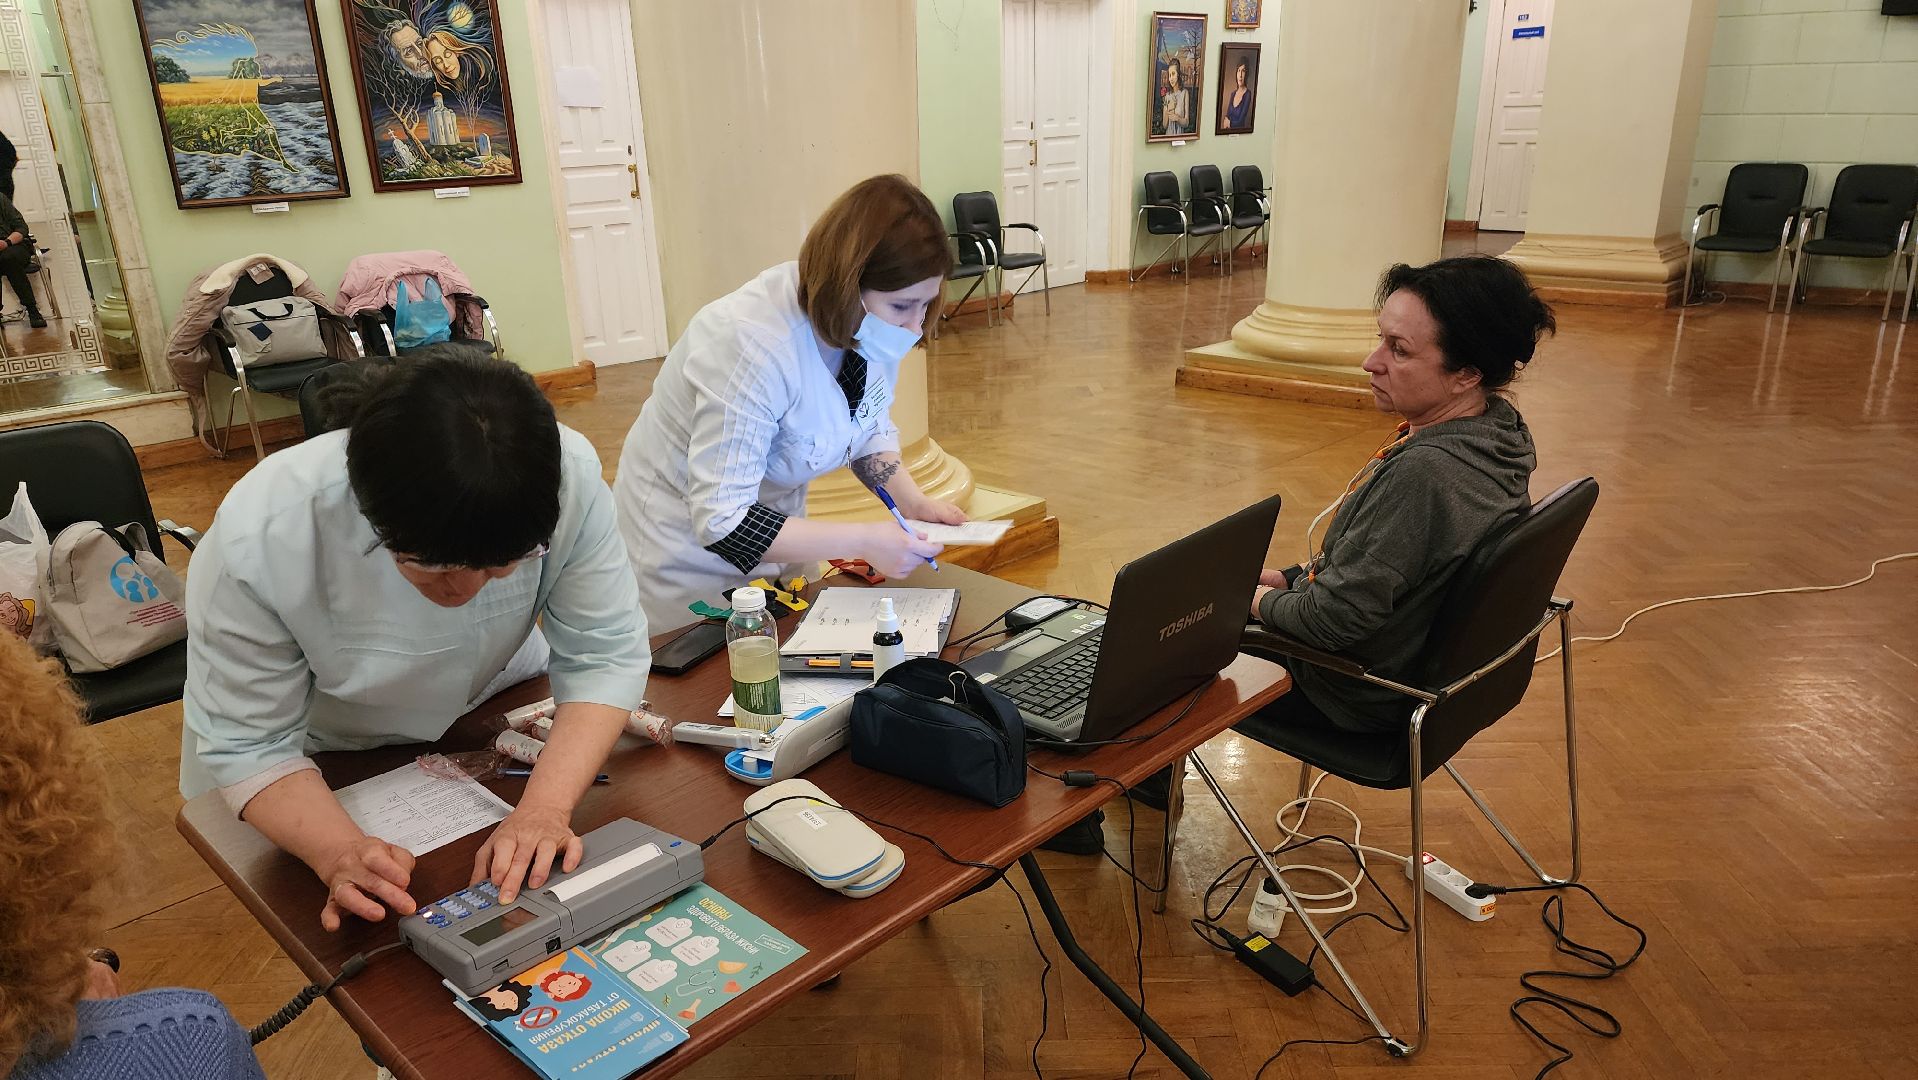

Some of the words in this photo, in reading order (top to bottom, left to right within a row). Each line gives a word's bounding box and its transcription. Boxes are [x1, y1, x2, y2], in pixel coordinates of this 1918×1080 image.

[1159, 602, 1213, 642] TOSHIBA
[698, 897, 734, 921] ОСНОВЫ
[686, 904, 719, 931] ЗДОРОВОГО
[735, 937, 760, 955] ЖИЗНИ
[607, 991, 620, 1003] ОТ
[528, 999, 608, 1045] ТАБАКОКУРЕНИЯ
[585, 999, 631, 1028] ШКОЛА
[537, 1024, 588, 1054] ОТКАЗА
